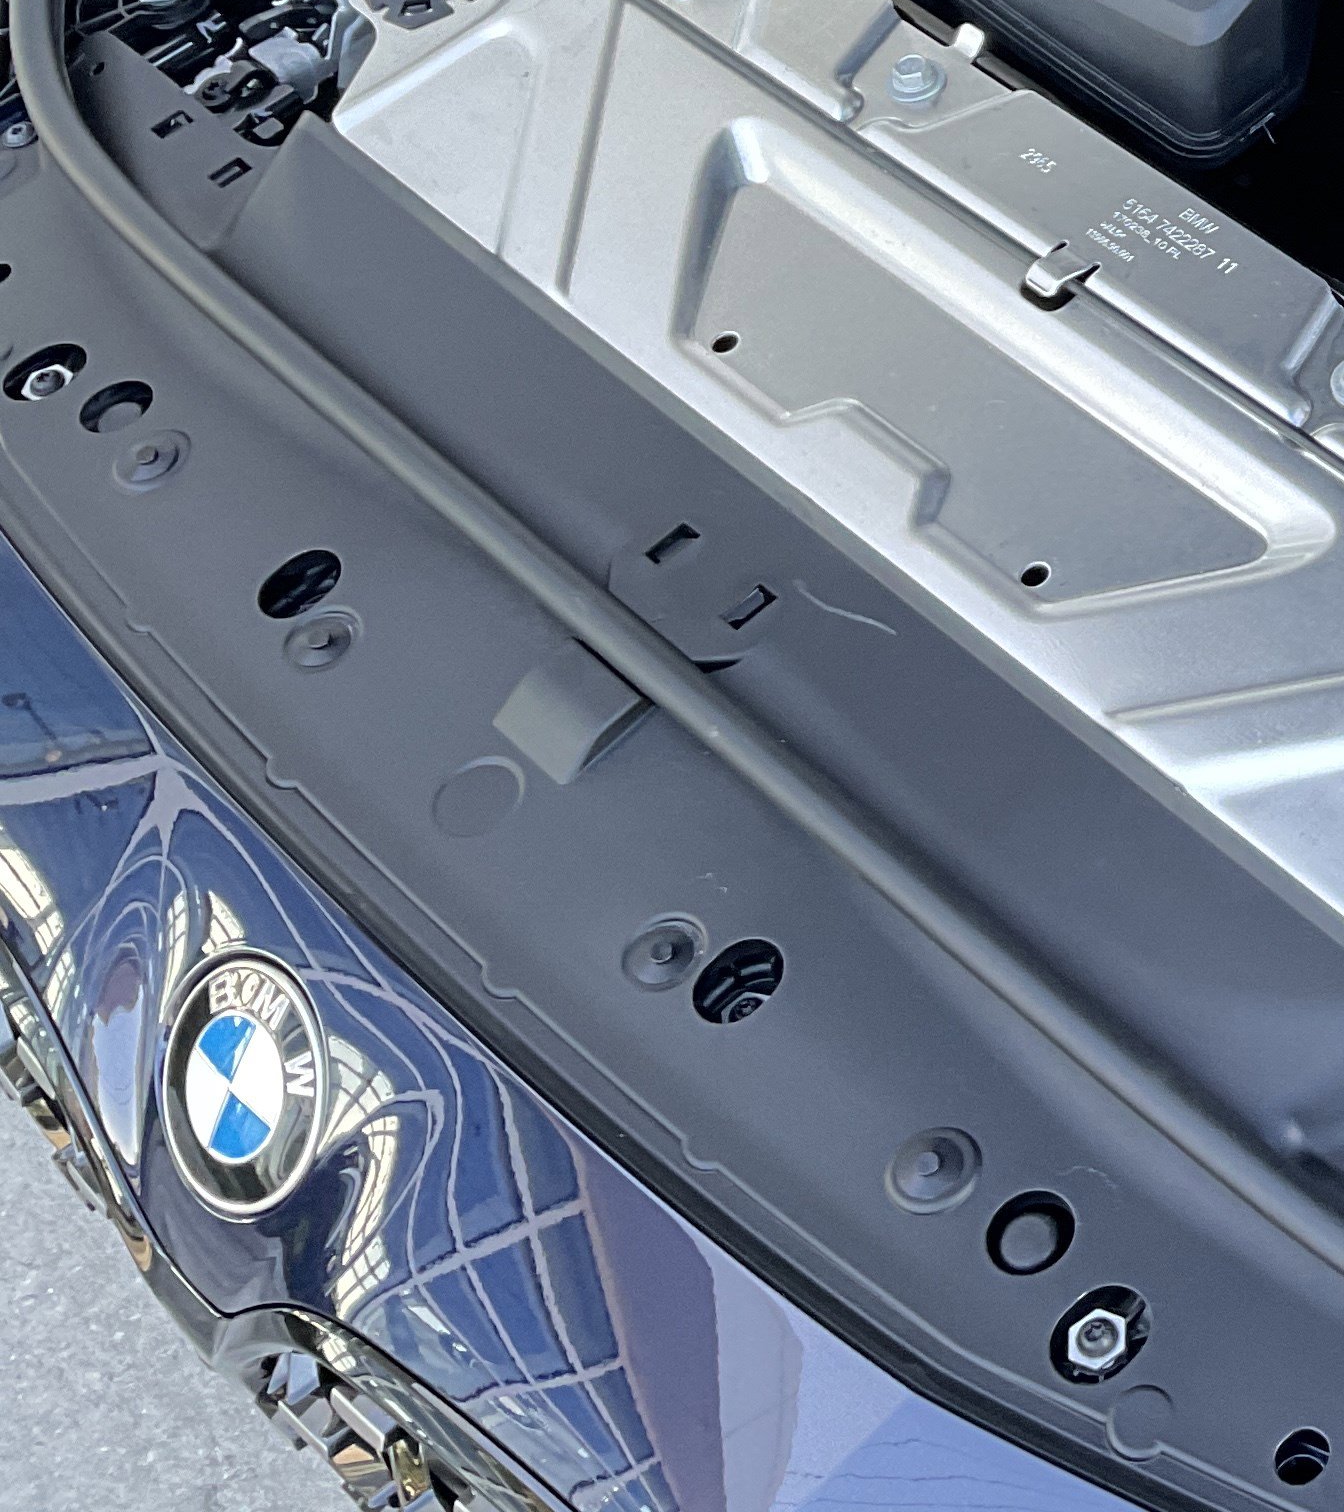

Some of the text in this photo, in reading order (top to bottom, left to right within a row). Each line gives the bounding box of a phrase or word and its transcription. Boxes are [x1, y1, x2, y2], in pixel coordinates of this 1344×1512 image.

[1122, 198, 1160, 225] 5164
[1155, 219, 1216, 259] 7422287
[1216, 257, 1239, 274] 11
[1178, 207, 1220, 235] BMW
[208, 968, 315, 1101] BMW
